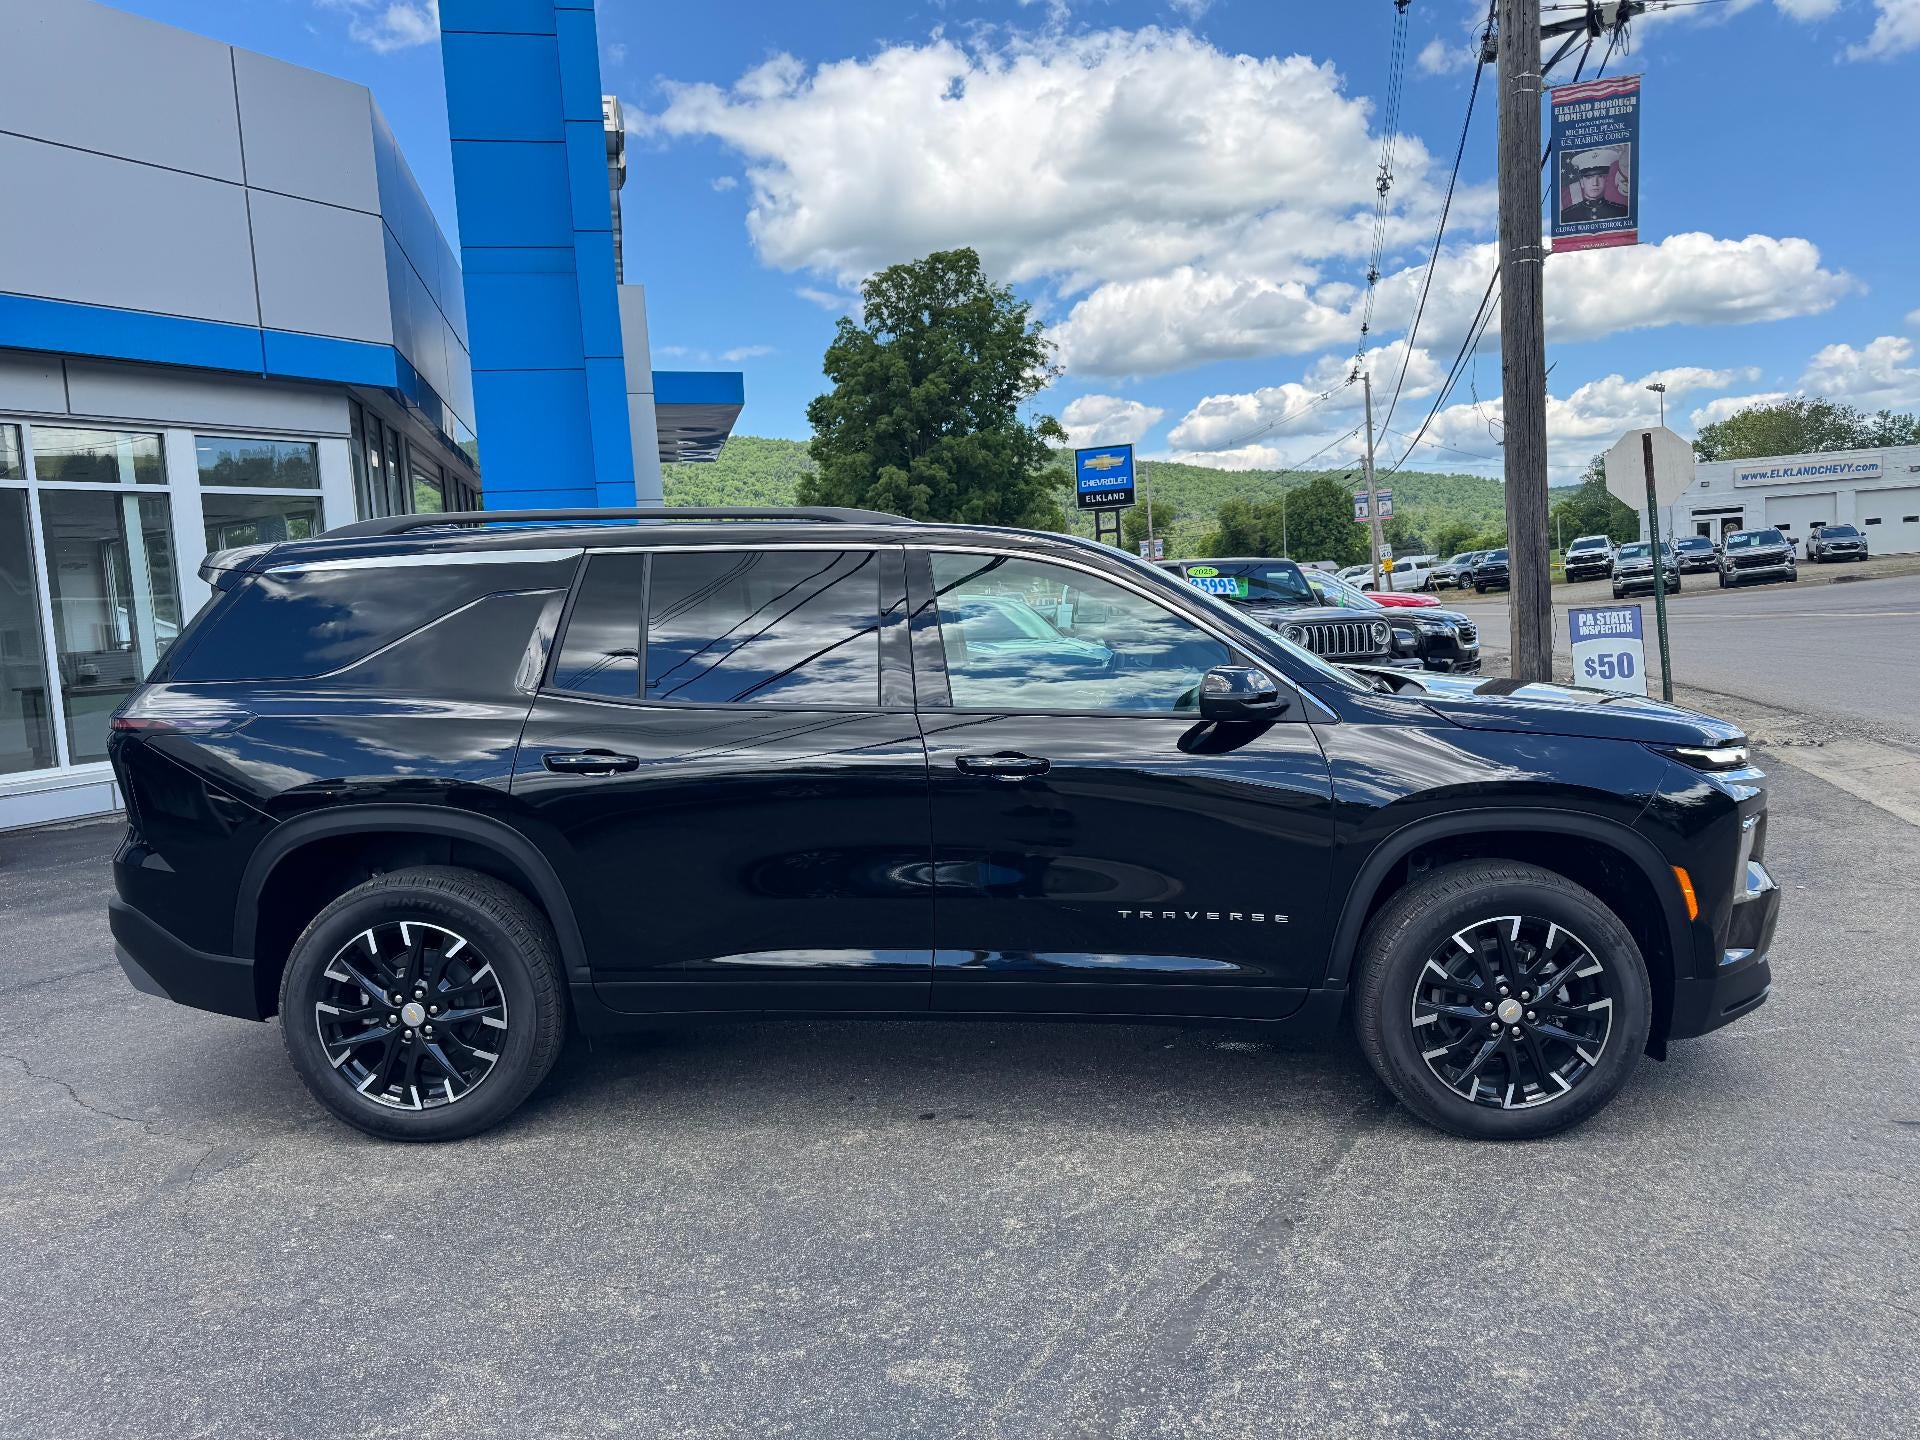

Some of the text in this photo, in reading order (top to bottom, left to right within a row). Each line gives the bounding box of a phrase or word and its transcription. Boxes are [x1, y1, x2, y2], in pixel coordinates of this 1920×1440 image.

[1554, 96, 1637, 115] ELKLAND BOROUGH
[1558, 105, 1634, 123] HOMETOWN HERO
[1565, 122, 1625, 137] MICHAEL PLANK
[1574, 134, 1604, 145] MARINE
[1605, 131, 1630, 141] CORPS
[1741, 462, 1879, 481] www.ELKLANDCHEVY.com
[1081, 476, 1128, 488] CHEVROLET
[1085, 492, 1125, 503] ELKLAND
[1193, 568, 1214, 576] 2025
[1578, 610, 1633, 627] PA STATE
[1579, 623, 1634, 636] INSPECTION
[1584, 651, 1635, 680] $50
[1117, 910, 1290, 923] TRAVERSE
